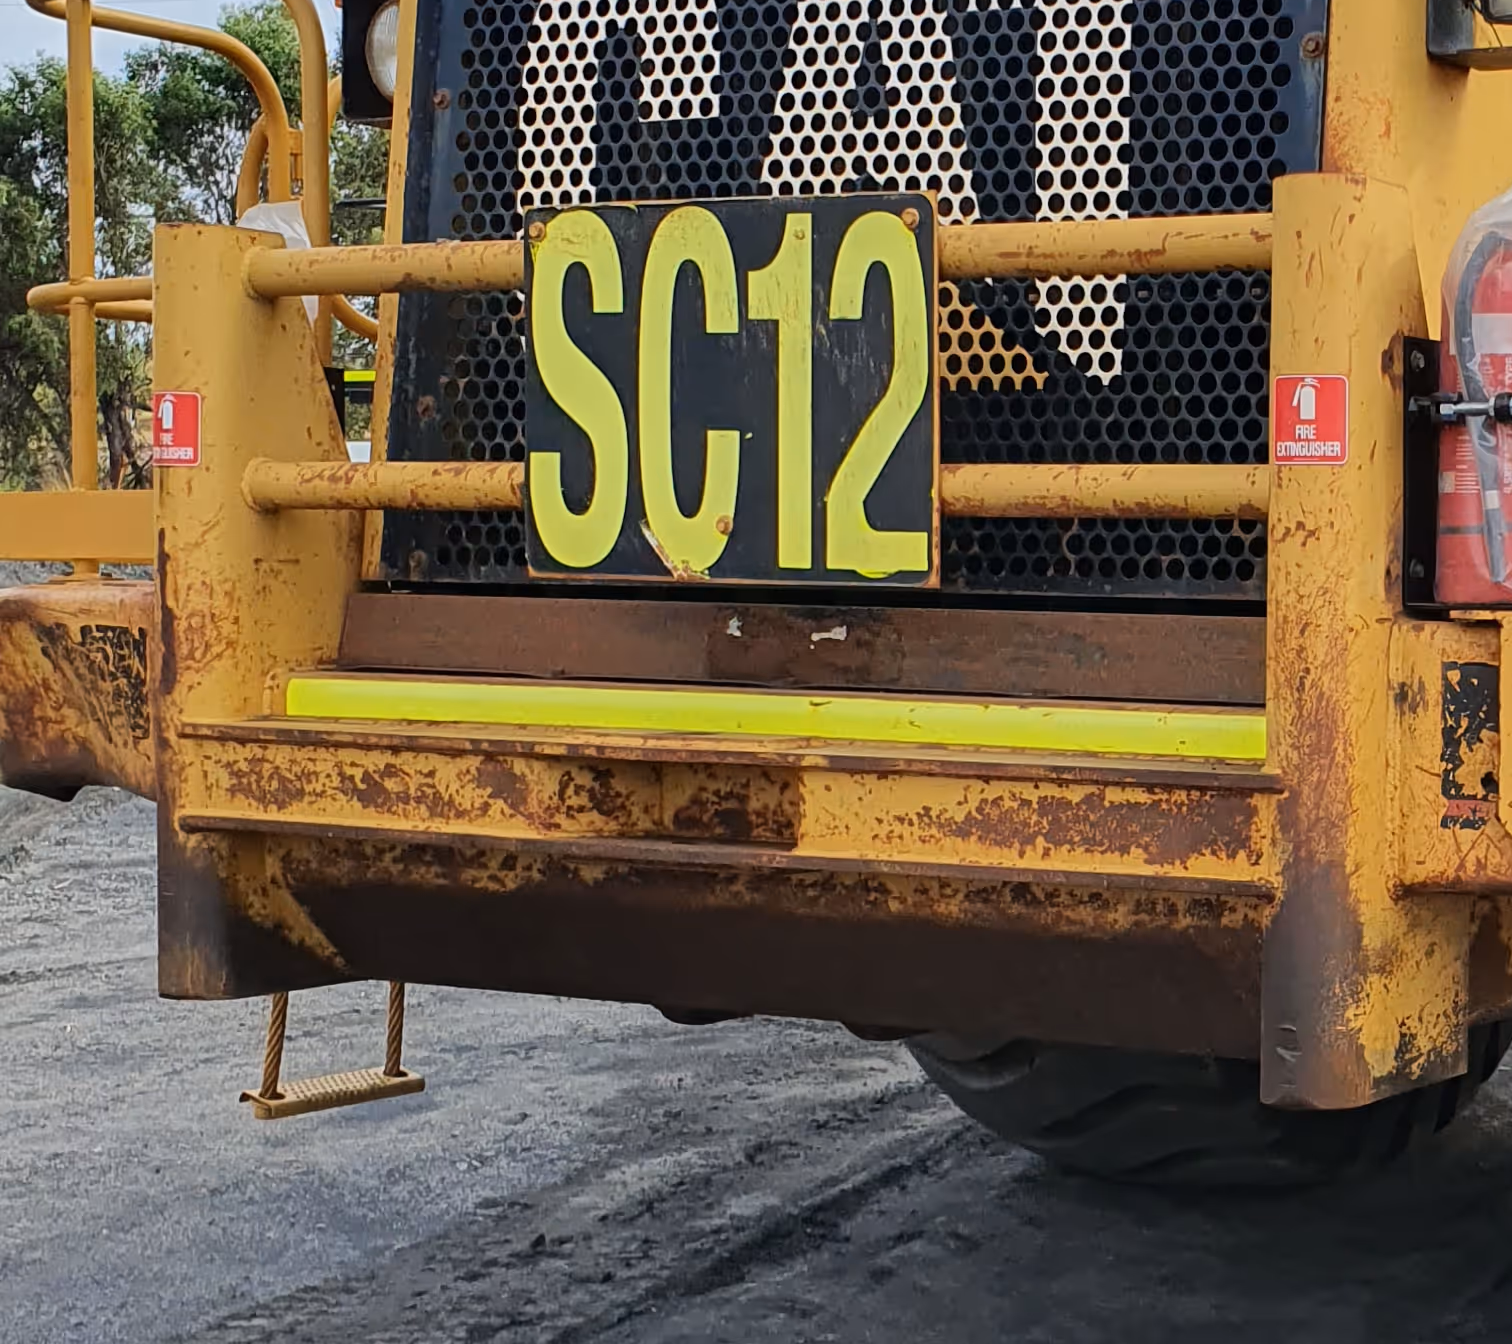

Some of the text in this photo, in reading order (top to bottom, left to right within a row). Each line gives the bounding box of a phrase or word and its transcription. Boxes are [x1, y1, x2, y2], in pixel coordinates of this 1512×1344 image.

[529, 206, 930, 578] SC12
[1295, 425, 1317, 439] FIRE
[1277, 441, 1341, 456] EXTINGUISHER
